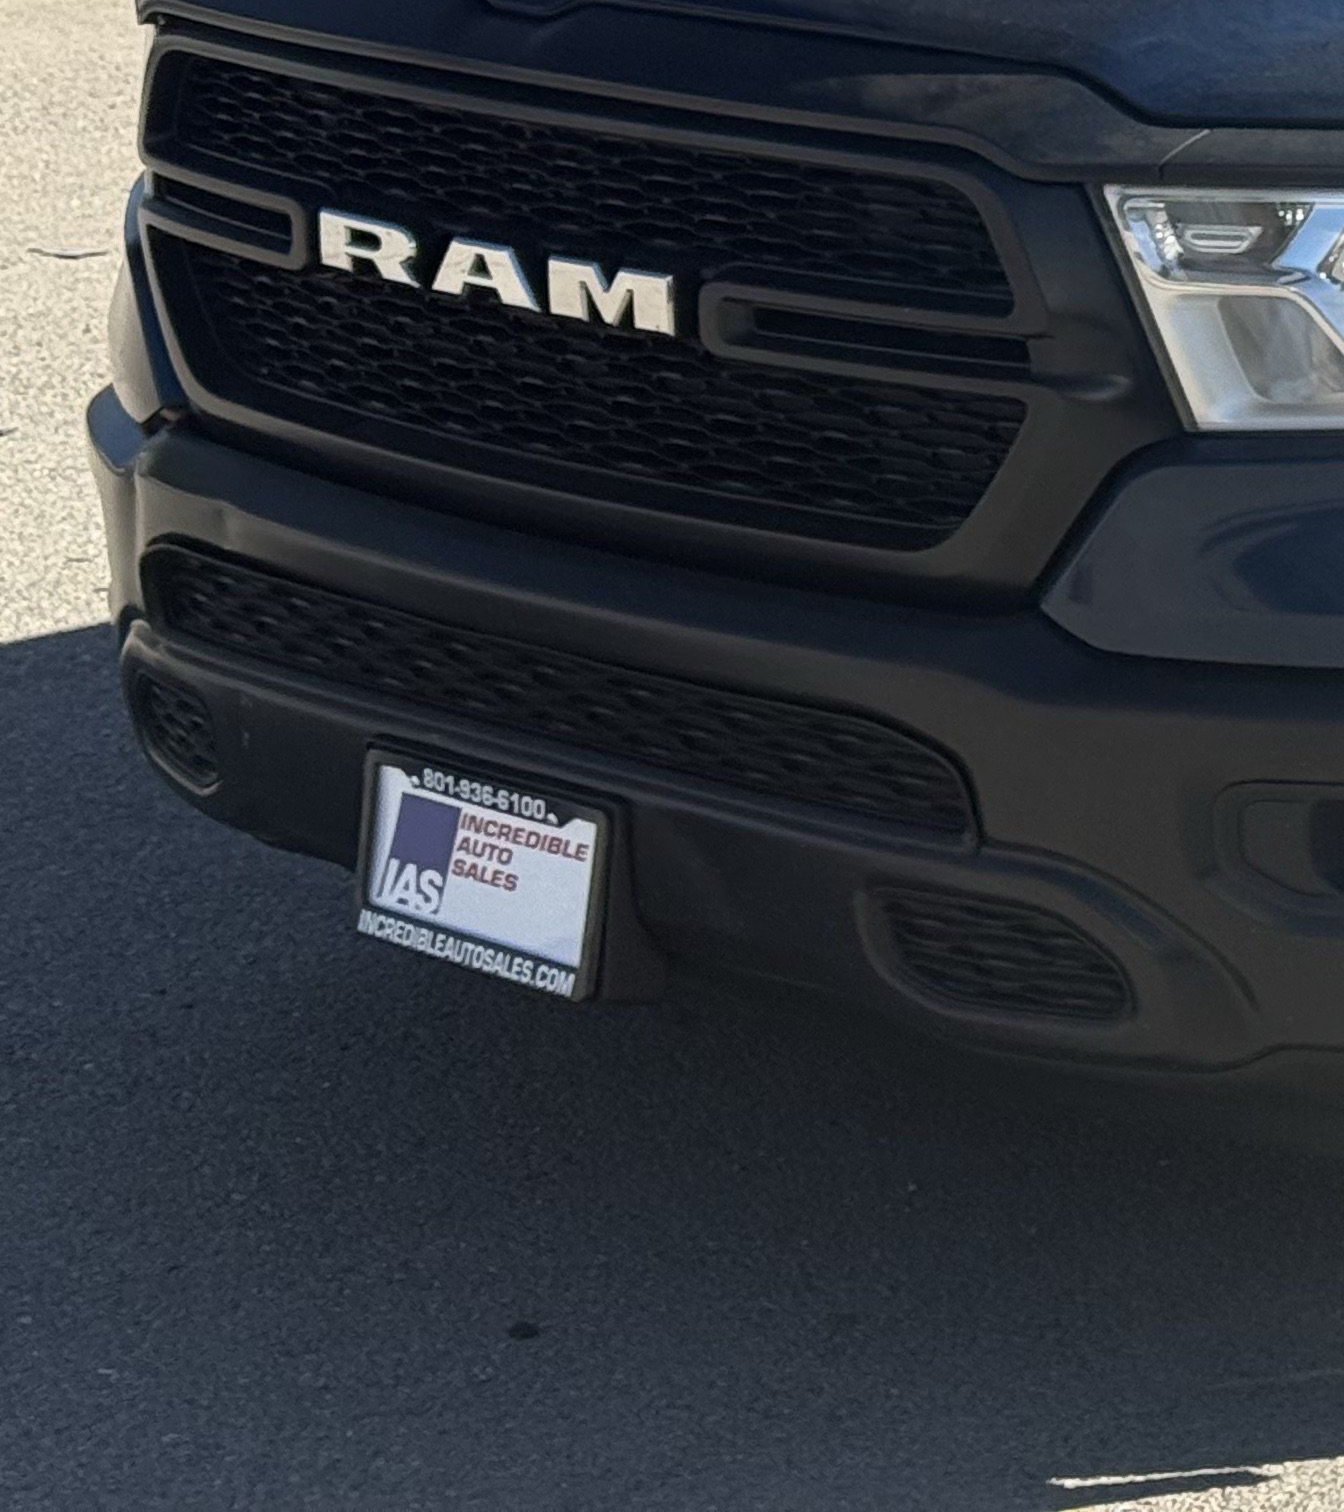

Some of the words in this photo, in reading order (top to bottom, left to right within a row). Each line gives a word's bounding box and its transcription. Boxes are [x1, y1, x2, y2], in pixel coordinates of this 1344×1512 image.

[318, 206, 676, 337] RAM
[422, 767, 546, 820] 801-936-6100
[456, 837, 514, 866] AUTO
[460, 813, 590, 862] INCREDIBLE
[451, 859, 520, 892] SALES
[356, 908, 577, 998] INCREDIBLEAUTOSALES.COM
